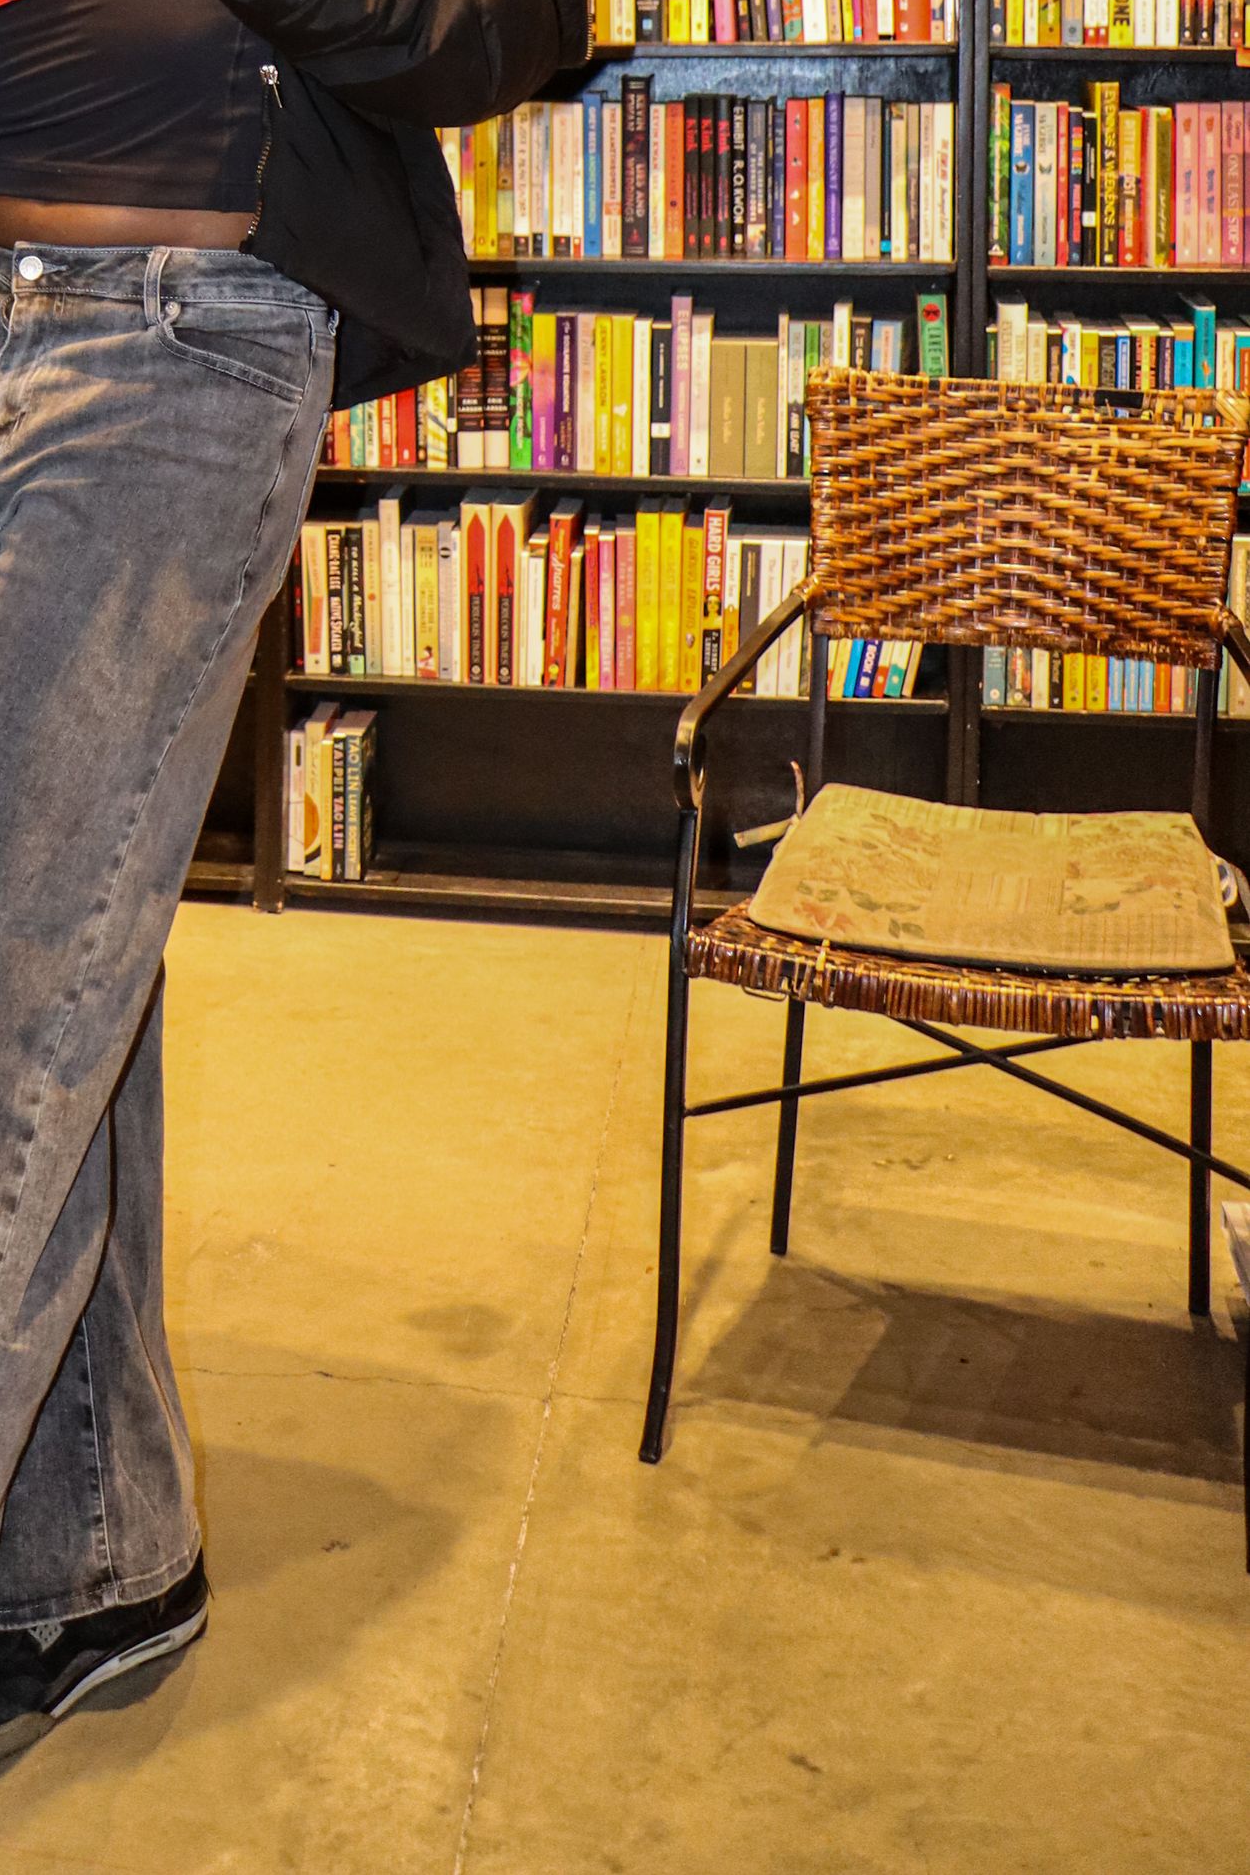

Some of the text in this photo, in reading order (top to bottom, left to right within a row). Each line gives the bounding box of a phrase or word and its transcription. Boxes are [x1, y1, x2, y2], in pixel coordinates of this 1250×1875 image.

[707, 516, 724, 592] HARD GIRLS
[348, 737, 360, 863] TAO LIN LEAVE SOCIETY
